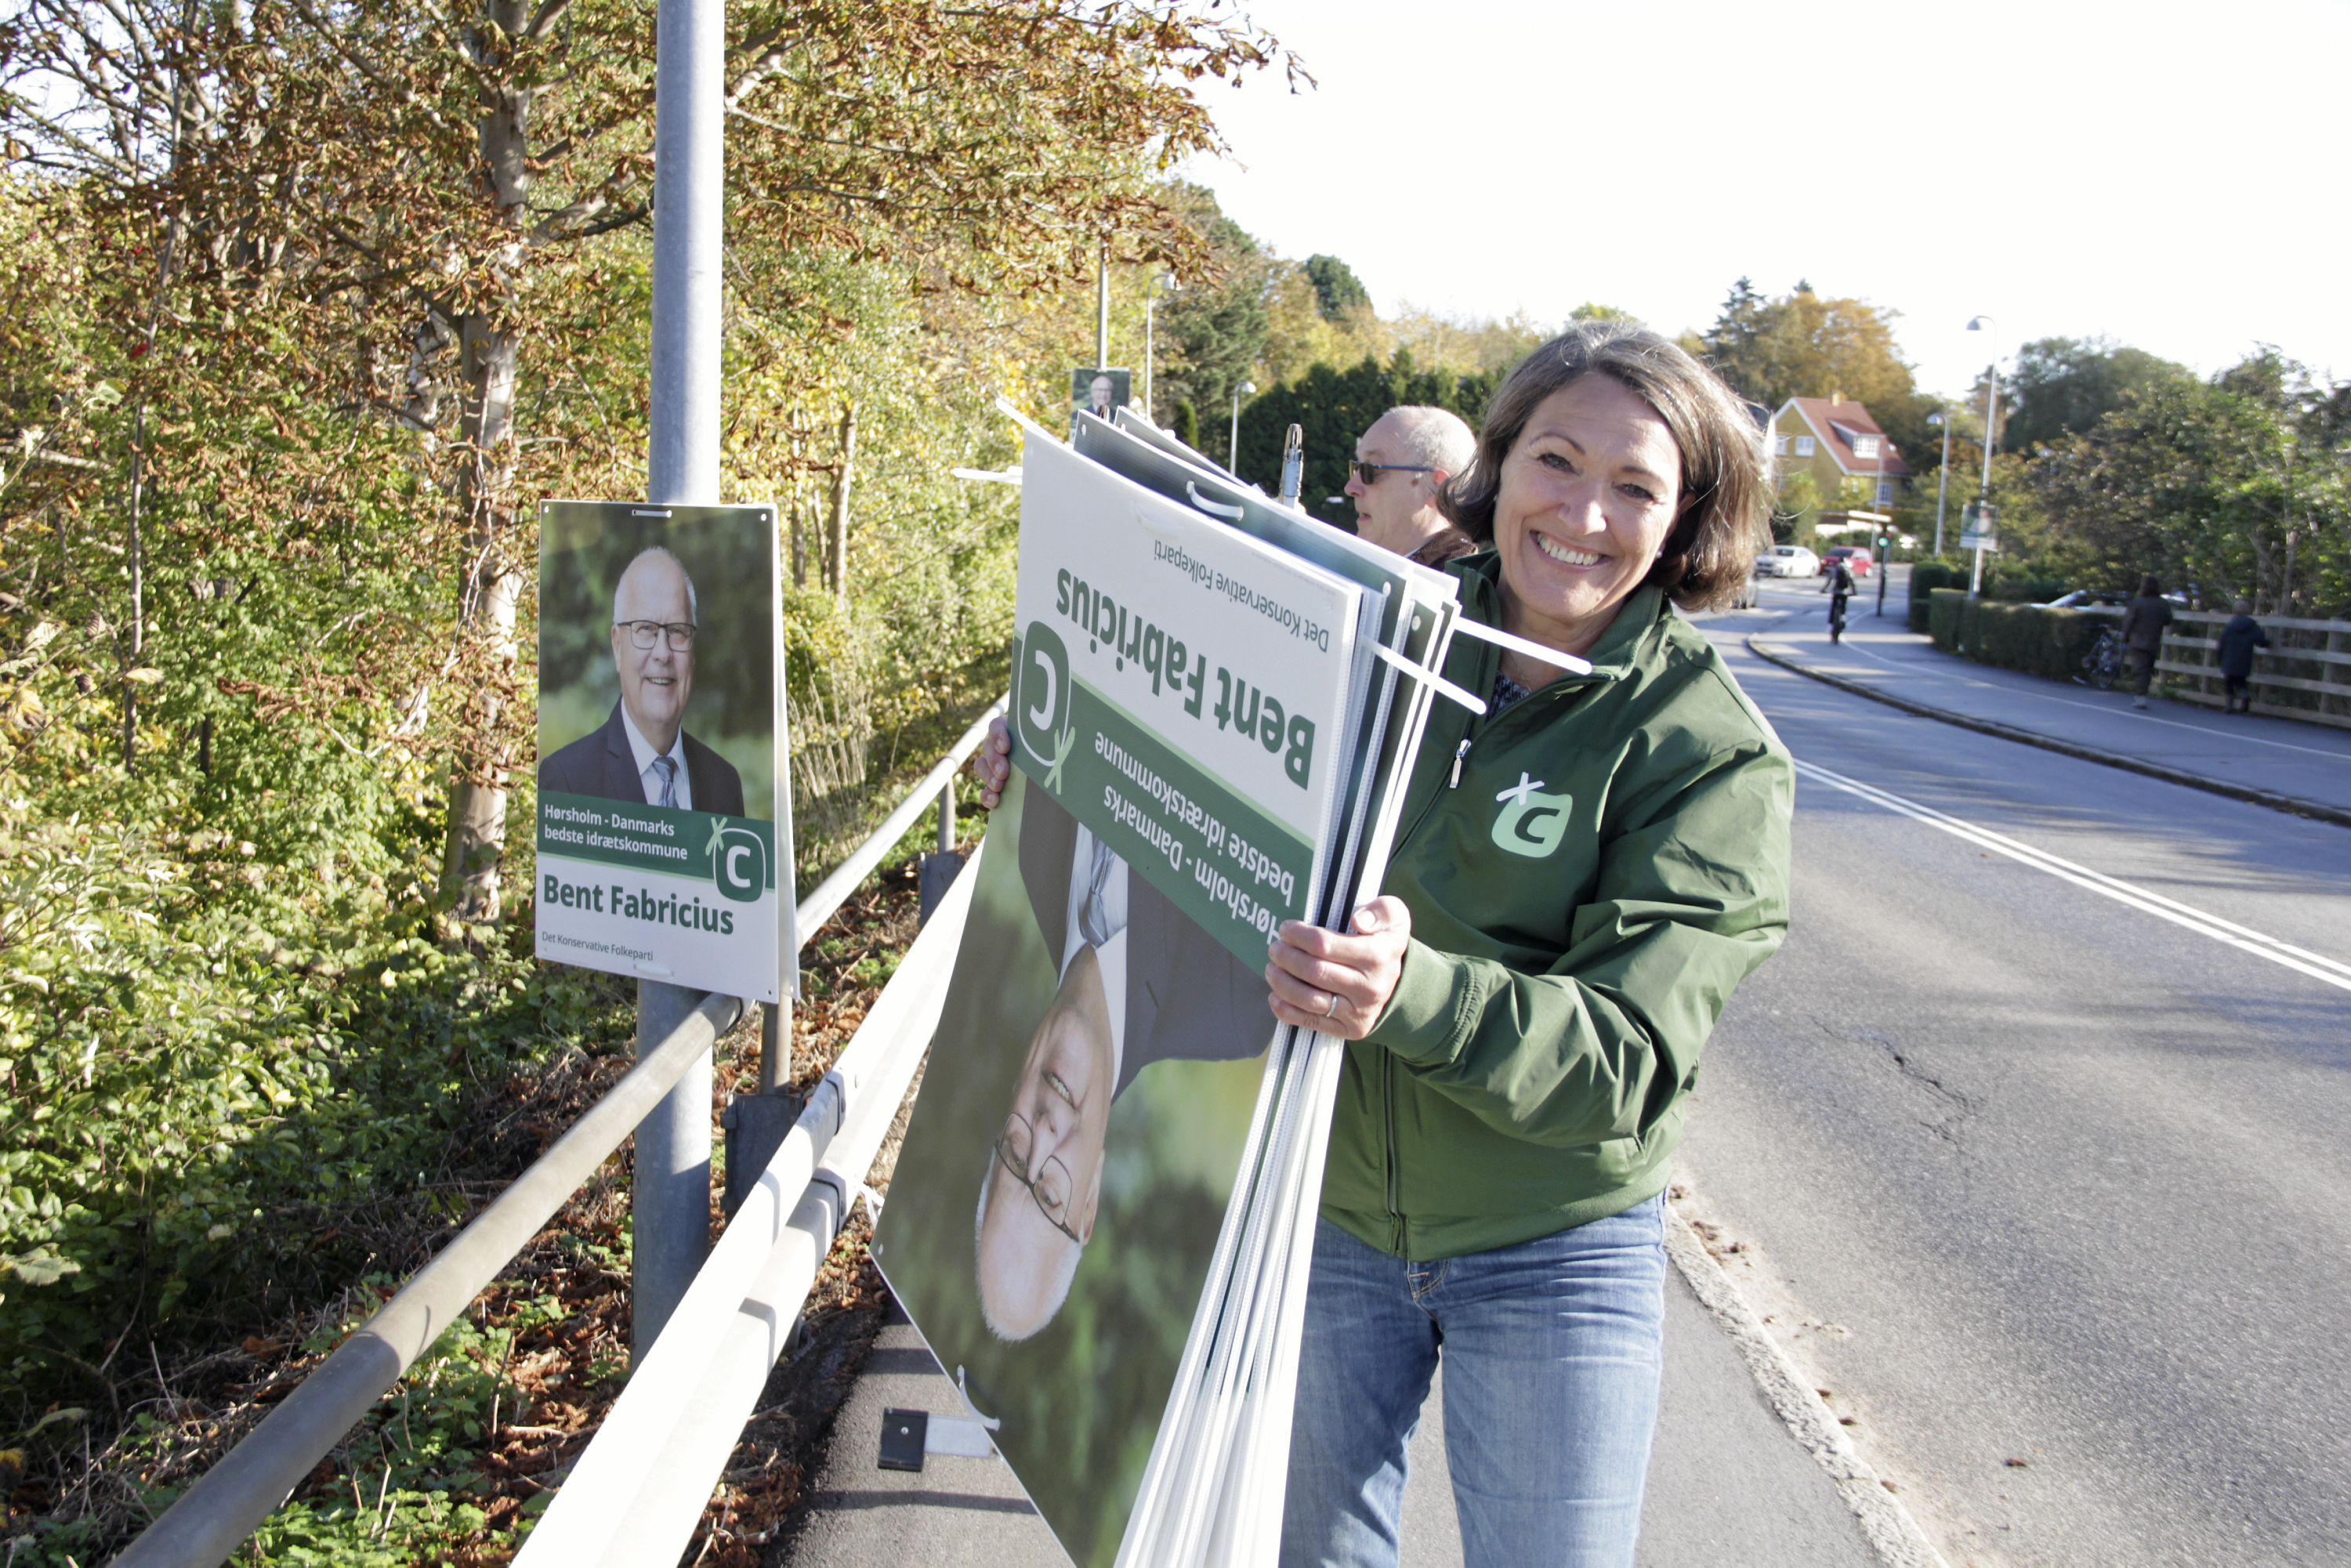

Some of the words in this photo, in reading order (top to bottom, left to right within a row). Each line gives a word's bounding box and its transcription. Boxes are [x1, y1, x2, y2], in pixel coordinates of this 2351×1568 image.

[1154, 539, 1212, 590] Folkeparti
[1216, 573, 1300, 637] Konservative
[1056, 567, 1207, 720] Fabricius
[1303, 623, 1329, 653] Det
[1029, 650, 1056, 730] C
[1214, 667, 1316, 791] Bent
[545, 804, 602, 825] Hørsholm
[611, 813, 675, 836] Danmarks
[1095, 731, 1226, 856] idrætskommune
[545, 824, 584, 844] bedste
[586, 831, 688, 860] idrætskommune
[1103, 785, 1183, 871] Danmarks
[1514, 806, 1561, 844] C
[726, 845, 752, 888] C
[1229, 833, 1295, 907] bedste
[543, 874, 603, 912] Bent
[610, 885, 734, 935] Fabricius
[542, 931, 556, 943] Det
[557, 934, 610, 954] Konservative
[611, 944, 654, 961] Folkeparti
